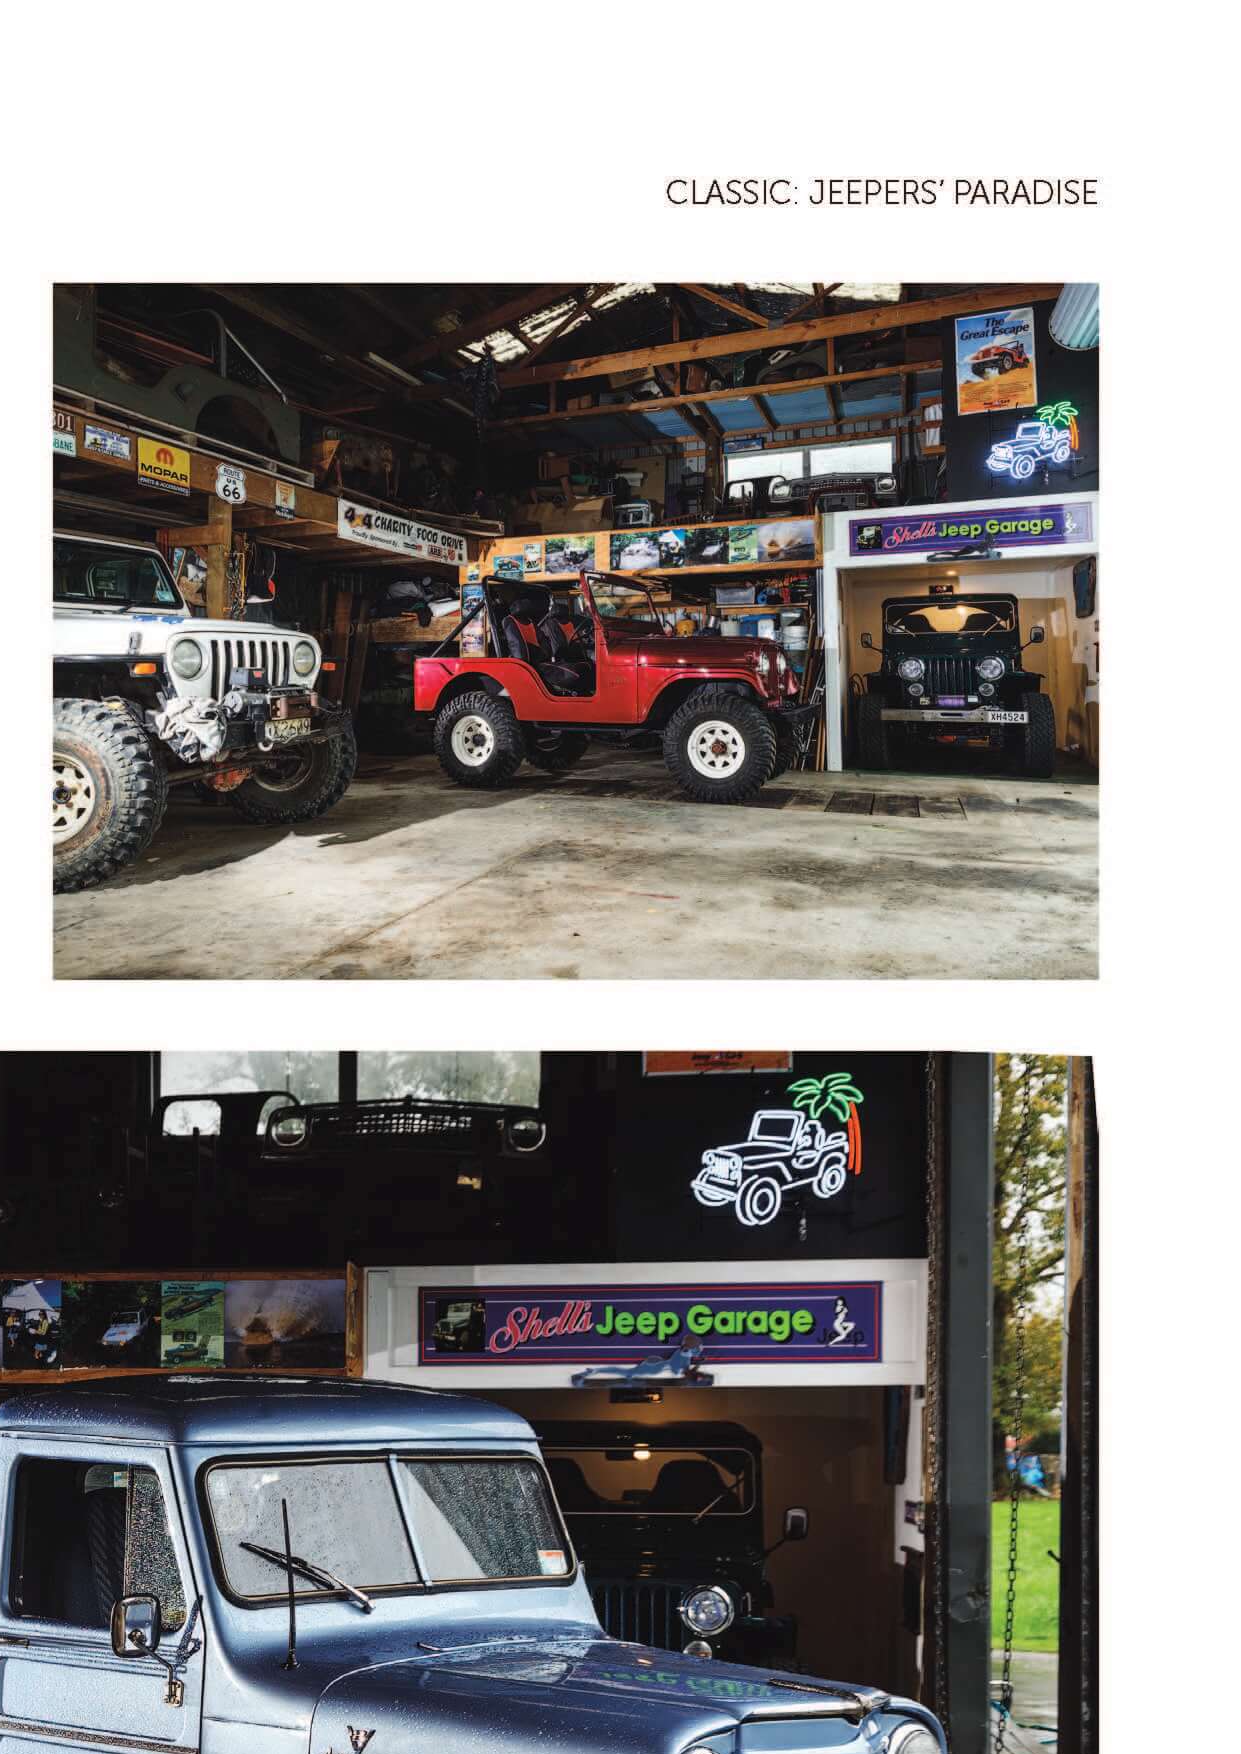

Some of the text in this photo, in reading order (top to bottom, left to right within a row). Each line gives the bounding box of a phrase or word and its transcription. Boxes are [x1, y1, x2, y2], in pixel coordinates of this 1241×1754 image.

[960, 322, 1030, 340] Great Escape
[985, 317, 1005, 328] The
[140, 462, 189, 483] MOPAR
[223, 467, 241, 479] ROUTE
[222, 484, 241, 500] 66
[374, 515, 414, 537] CHARITY
[416, 527, 438, 543] FOOD
[440, 535, 464, 551] DRIVE
[938, 521, 983, 538] Jeep
[985, 516, 1056, 534] Garage
[991, 712, 1025, 722] XH4524
[595, 1306, 682, 1341] Jeep
[686, 1304, 816, 1342] Garage
